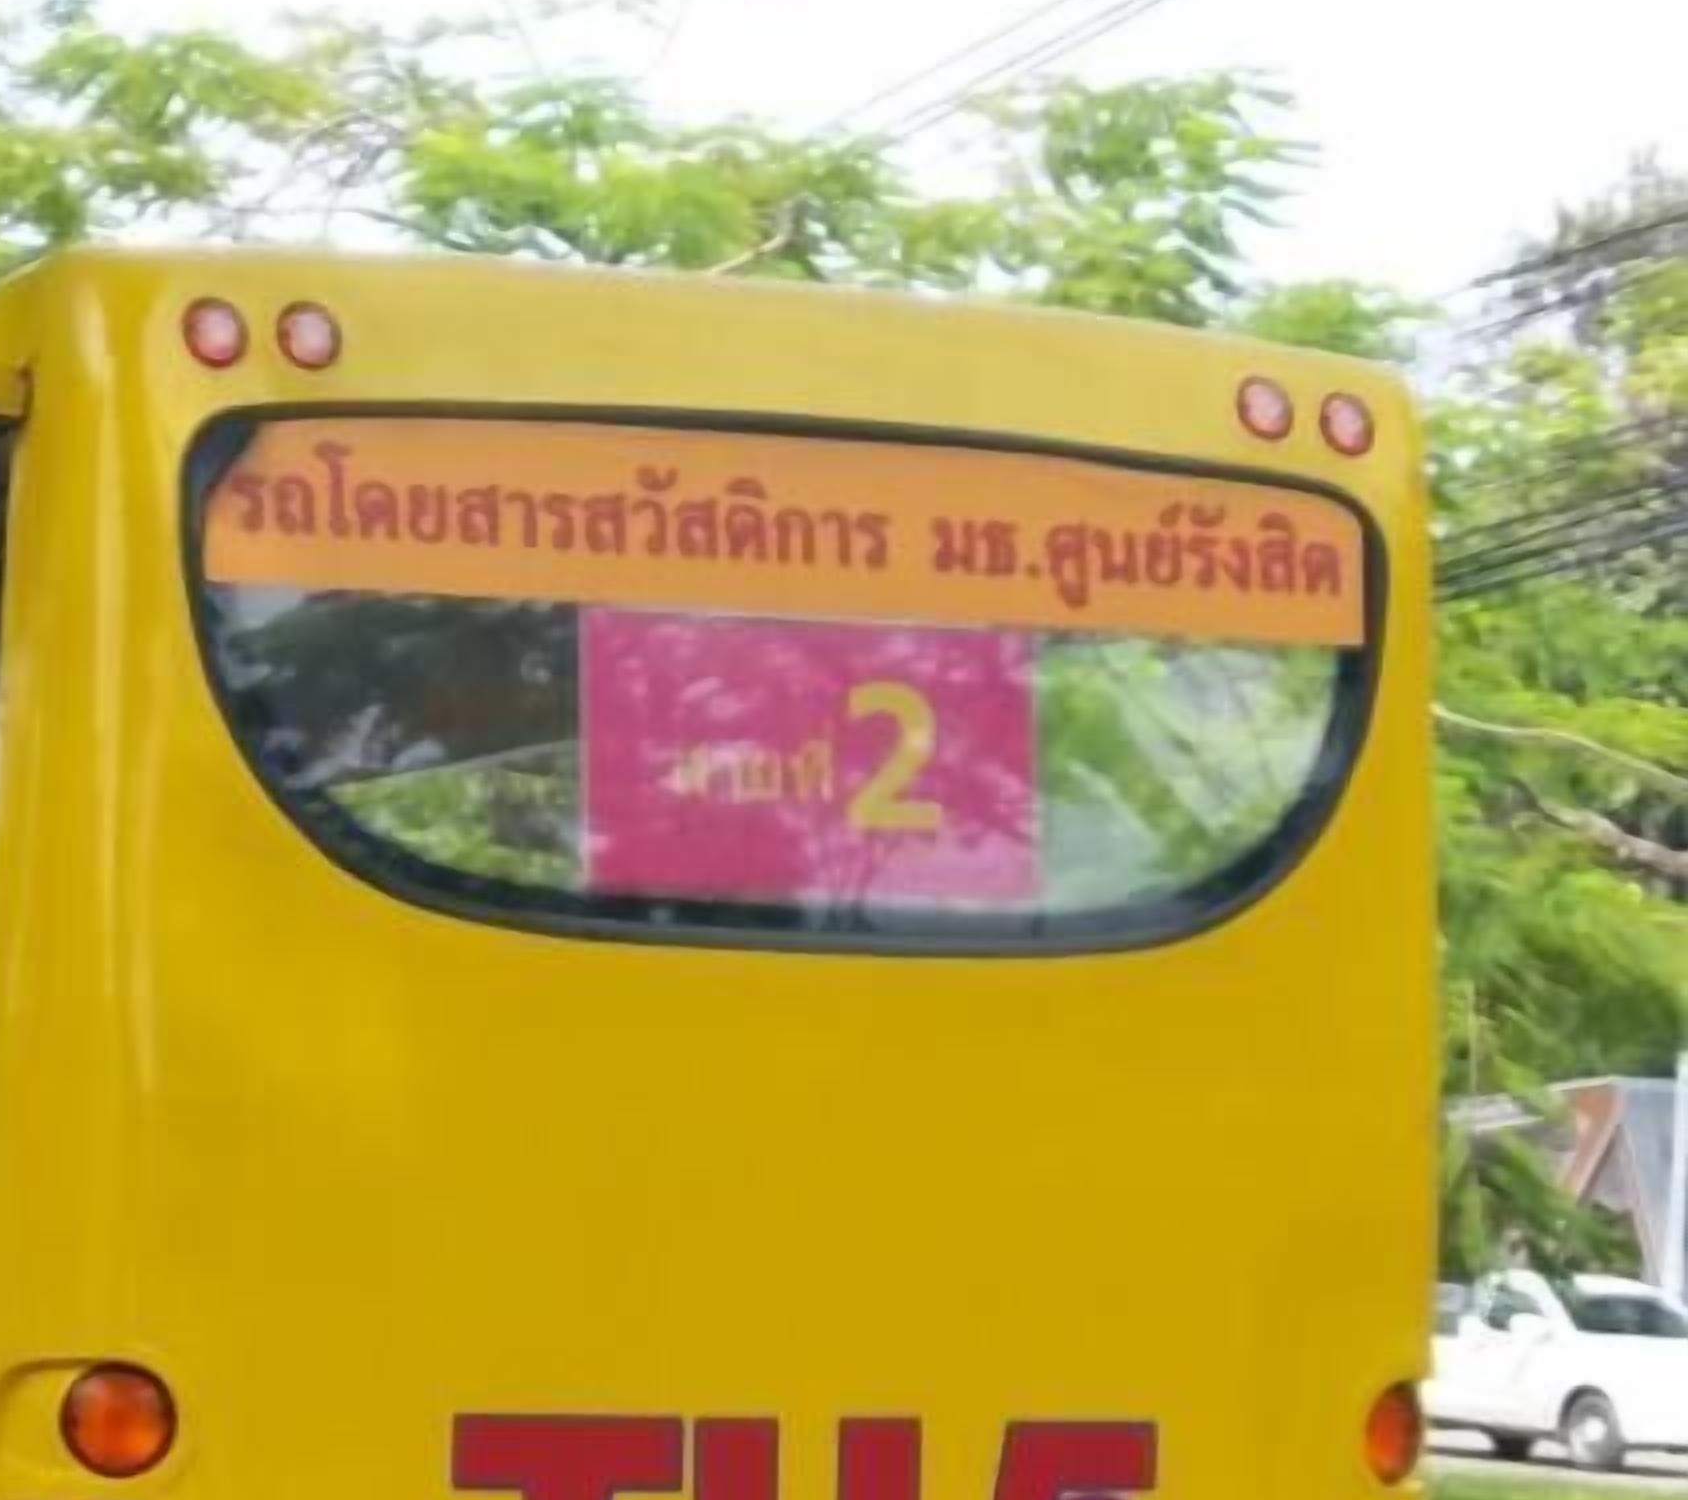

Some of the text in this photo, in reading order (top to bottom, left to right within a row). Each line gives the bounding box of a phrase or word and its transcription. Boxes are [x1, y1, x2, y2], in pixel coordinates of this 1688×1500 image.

[229, 441, 1342, 610] รถโดยสารสวัสดิการ มธ.ศูนย์รังสิต
[847, 680, 944, 832] 2
